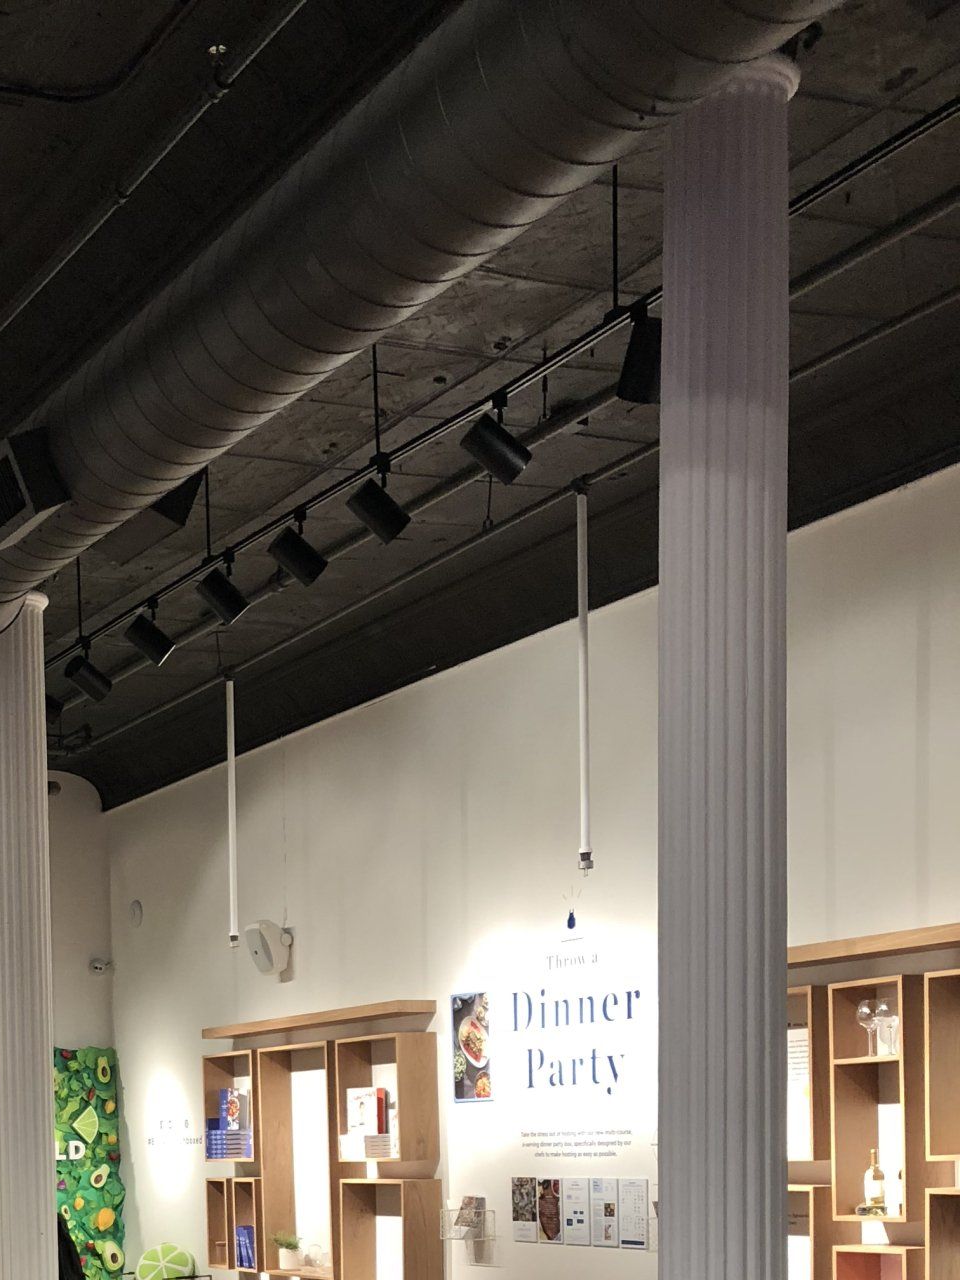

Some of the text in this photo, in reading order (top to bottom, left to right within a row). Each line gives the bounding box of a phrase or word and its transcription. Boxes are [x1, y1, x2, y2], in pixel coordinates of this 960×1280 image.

[547, 954, 598, 970] Throw a
[512, 988, 641, 1032] Dinner
[527, 1048, 625, 1095] Party
